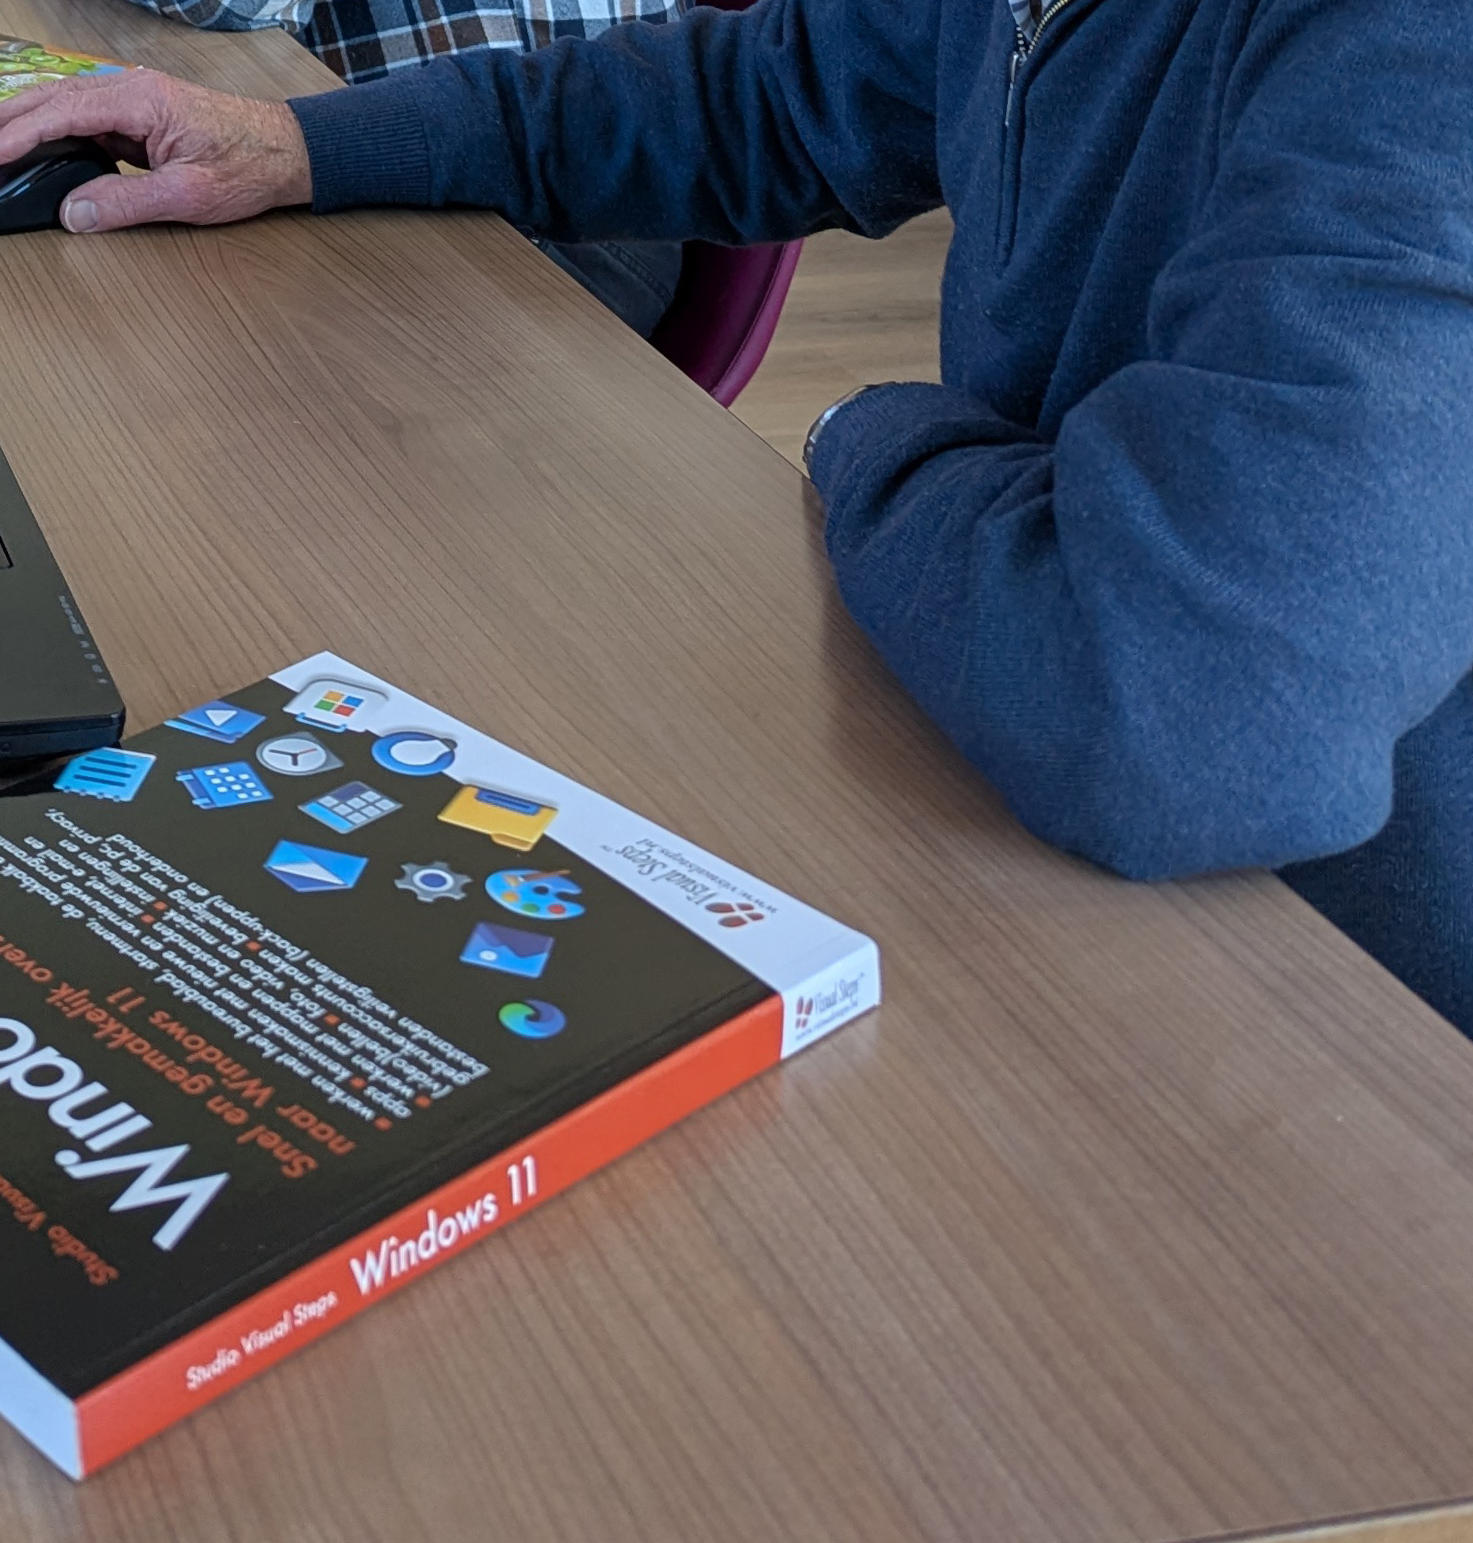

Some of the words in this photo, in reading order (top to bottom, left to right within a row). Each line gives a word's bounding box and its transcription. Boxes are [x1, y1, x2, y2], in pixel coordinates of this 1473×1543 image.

[23, 836, 45, 849] en
[44, 808, 102, 843] privacy,
[58, 839, 80, 852] en
[37, 848, 85, 876] e-mail
[98, 839, 125, 859] pc,
[106, 833, 188, 882] onderhoud
[119, 856, 141, 872] de
[0, 862, 63, 905] taakbalk
[77, 851, 155, 904] instellingen
[84, 875, 143, 917] internet,
[139, 867, 168, 891] van
[186, 882, 209, 896] en
[651, 869, 717, 905] Visual
[60, 881, 140, 936] vernieuwde
[61, 903, 84, 918] de
[162, 908, 219, 944] muziek
[167, 888, 248, 944] beveiliging
[203, 894, 308, 960] (back-uppen)
[85, 917, 159, 969] startmenu,
[140, 935, 168, 950] en
[152, 921, 231, 976] bestanden
[217, 943, 241, 958] en
[162, 950, 220, 988] nieuwe
[228, 973, 253, 989] en
[239, 958, 283, 989] video
[258, 949, 313, 984] maken
[106, 986, 144, 1013] 11
[154, 968, 252, 1037] bureaublad,
[213, 987, 248, 1009] met
[286, 987, 325, 1018] foto,
[305, 958, 396, 1018] veiligstellen
[251, 988, 319, 1033] mappen
[47, 982, 213, 1094] gemakkelijk
[246, 1033, 280, 1057] het
[247, 1008, 351, 1081] kennismaken
[311, 983, 470, 1089] gebruikersaccounts
[314, 1032, 352, 1055] met
[397, 1016, 489, 1079] bestanden
[149, 1010, 273, 1106] Windows
[274, 1052, 313, 1076] met
[337, 1022, 450, 1098] (video)bellen
[311, 1074, 374, 1119] werken
[351, 1054, 413, 1103] werken
[206, 1095, 248, 1124] en
[363, 1085, 411, 1117] apps
[277, 1105, 354, 1154] naar
[237, 1124, 317, 1177] Snel
[349, 1193, 499, 1296] Windows
[507, 1155, 538, 1207] 11
[47, 1224, 117, 1284] Studio
[186, 1348, 241, 1390] Studio
[240, 1310, 290, 1355] Visual
[293, 1290, 338, 1328] Steps
